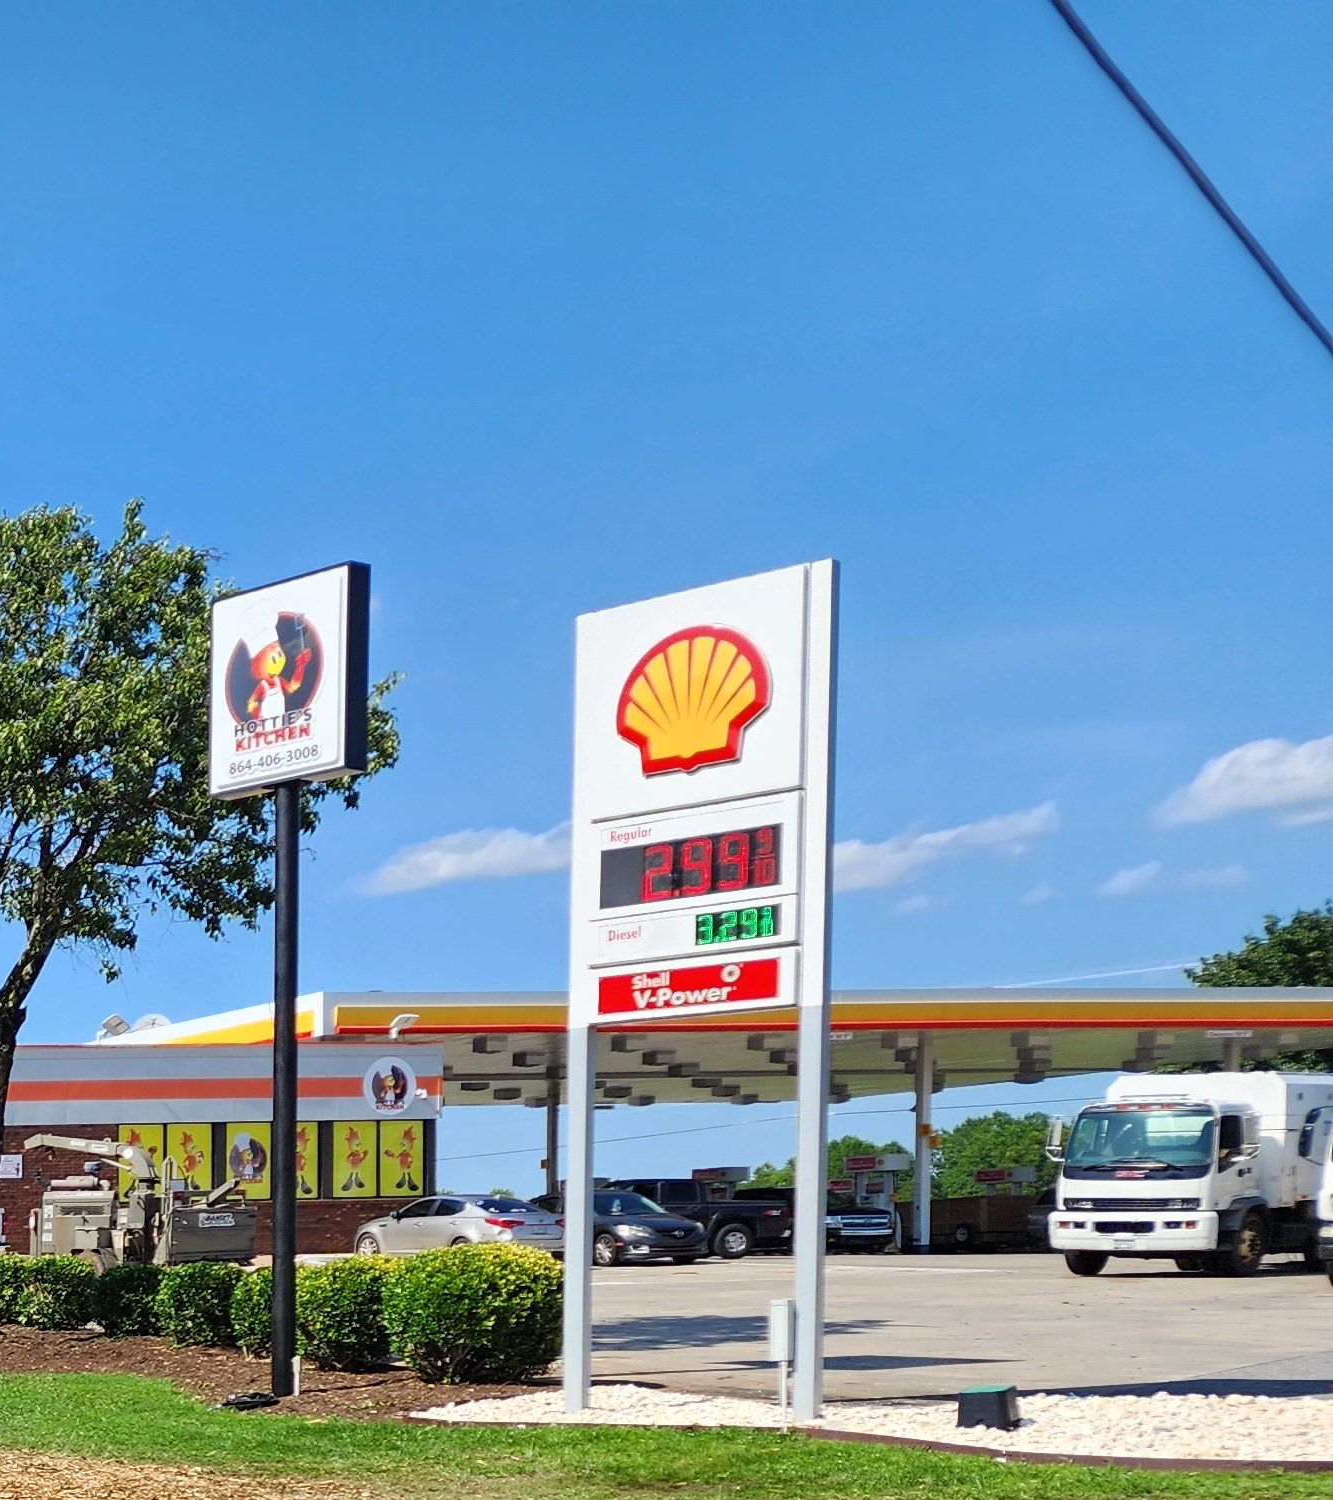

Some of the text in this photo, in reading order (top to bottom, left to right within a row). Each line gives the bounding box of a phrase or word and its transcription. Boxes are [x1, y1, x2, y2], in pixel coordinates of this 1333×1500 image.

[234, 708, 312, 737] HOTTIE'S
[235, 722, 312, 752] KITCHEN
[229, 744, 319, 775] 864-406-3008
[609, 826, 653, 843] Regular
[607, 926, 642, 942] Diesel
[631, 971, 670, 990] Shell
[632, 985, 733, 1009] V-Power
